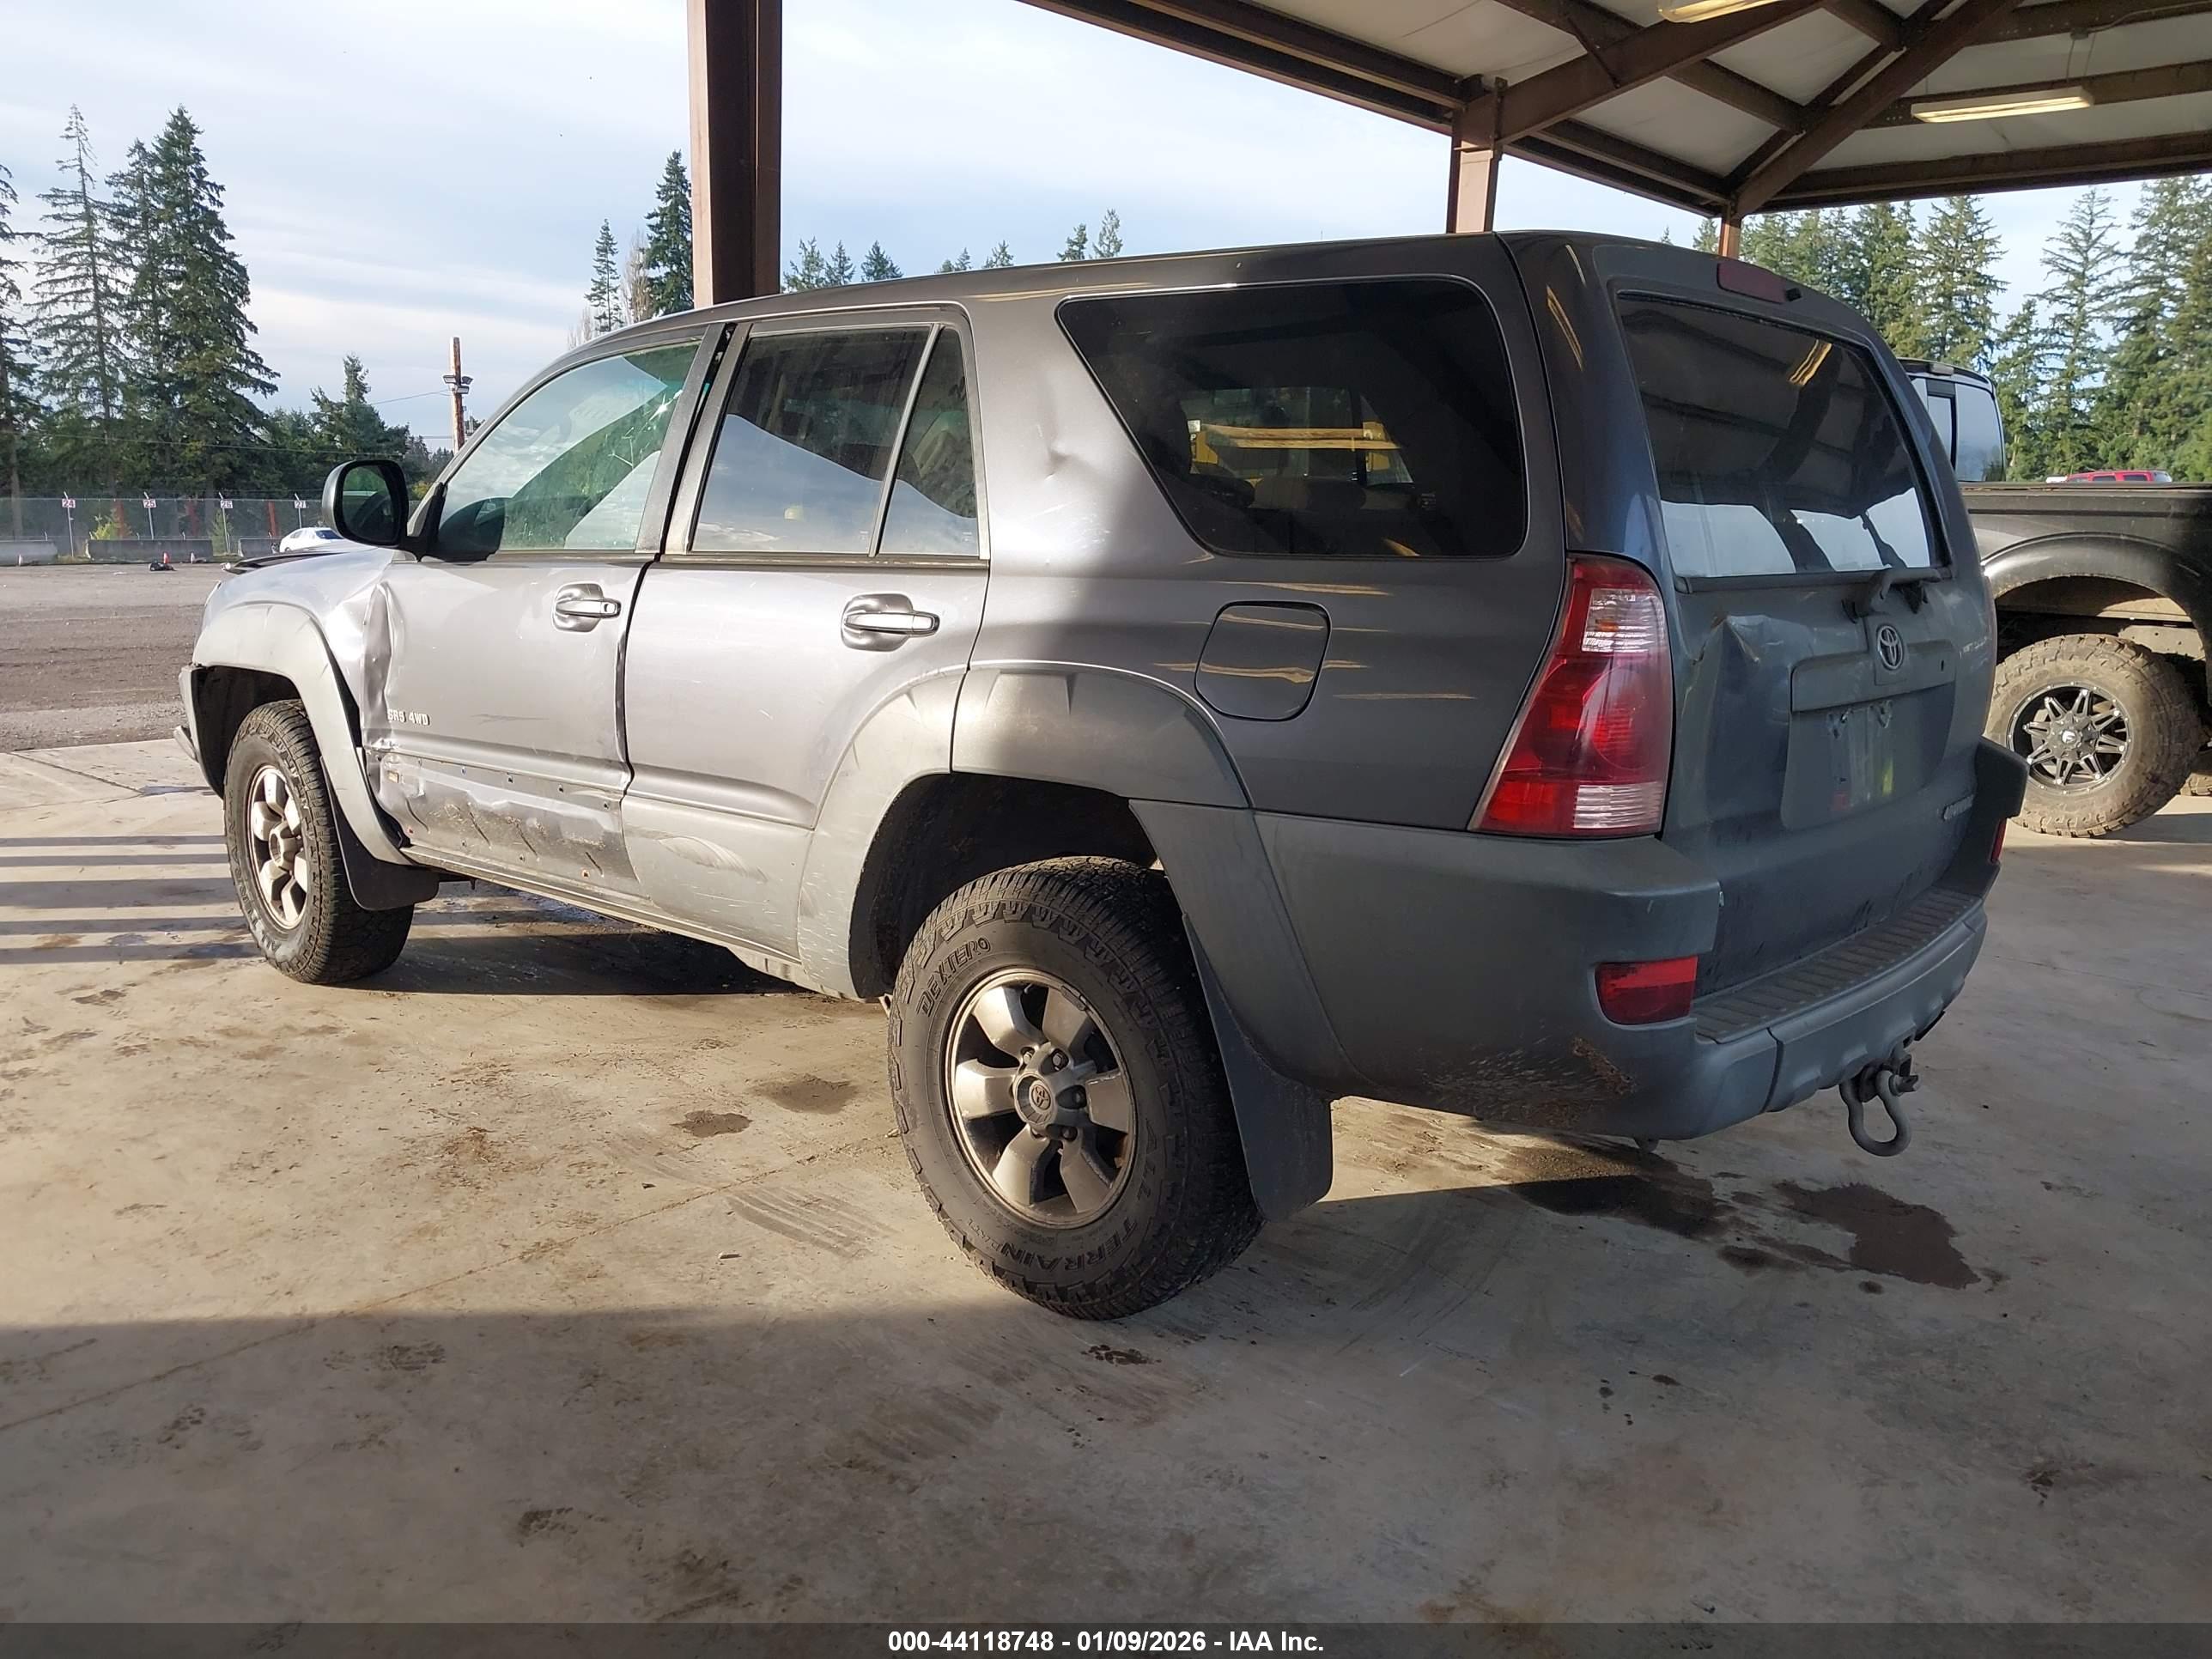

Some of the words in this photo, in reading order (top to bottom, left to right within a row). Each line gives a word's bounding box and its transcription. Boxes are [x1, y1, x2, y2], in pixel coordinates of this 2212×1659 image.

[409, 712, 429, 726] 4WD
[915, 938, 990, 1017] DEXTERO
[1000, 1217, 1138, 1272] TERRAIN
